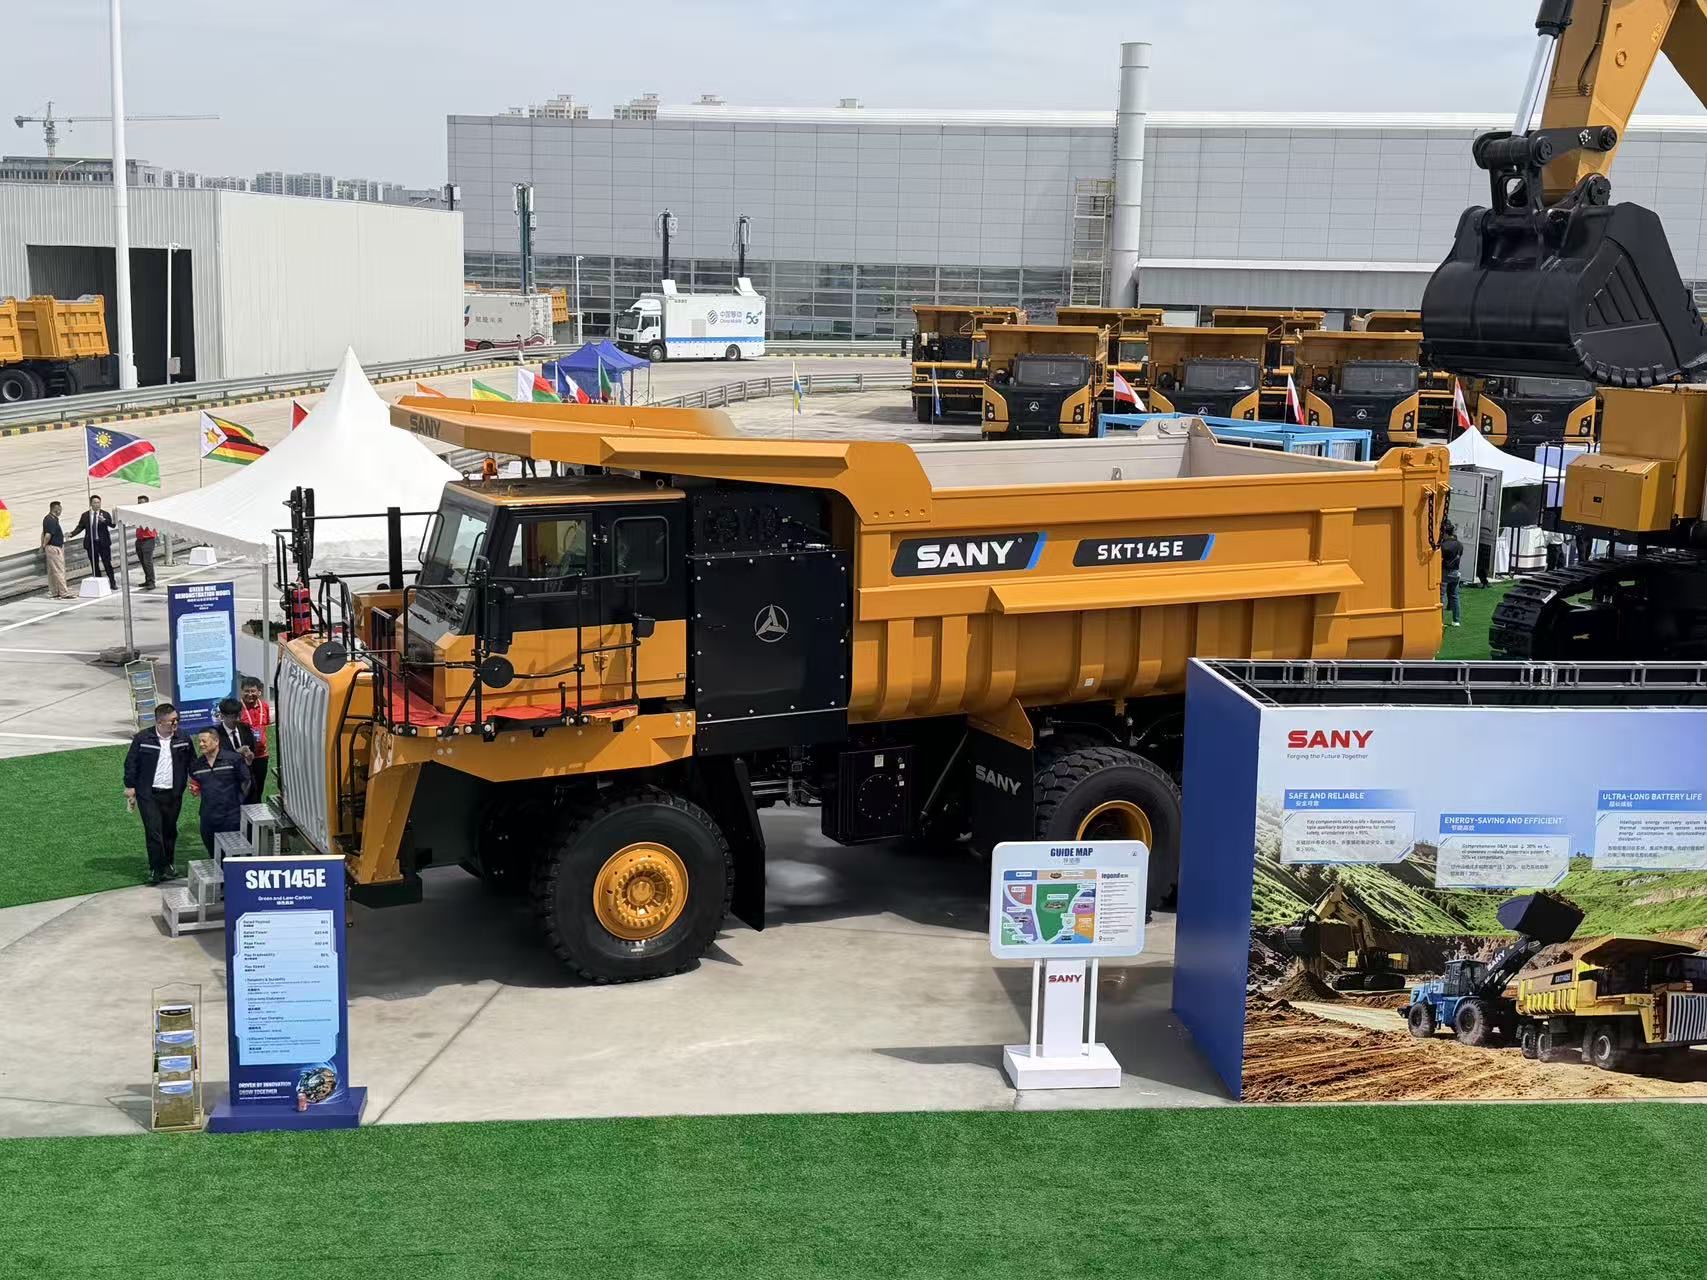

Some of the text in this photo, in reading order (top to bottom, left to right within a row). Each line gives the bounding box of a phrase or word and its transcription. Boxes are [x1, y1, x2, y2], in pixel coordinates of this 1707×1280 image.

[409, 414, 441, 439] SANY
[916, 540, 1015, 569] SANY
[1097, 541, 1184, 560] SKT145E
[1288, 730, 1374, 748] SANY
[975, 765, 1022, 795] SANY
[1050, 848, 1094, 857] GUIDE MAP
[246, 868, 326, 889] SKT145E
[1048, 974, 1082, 983] SANY
